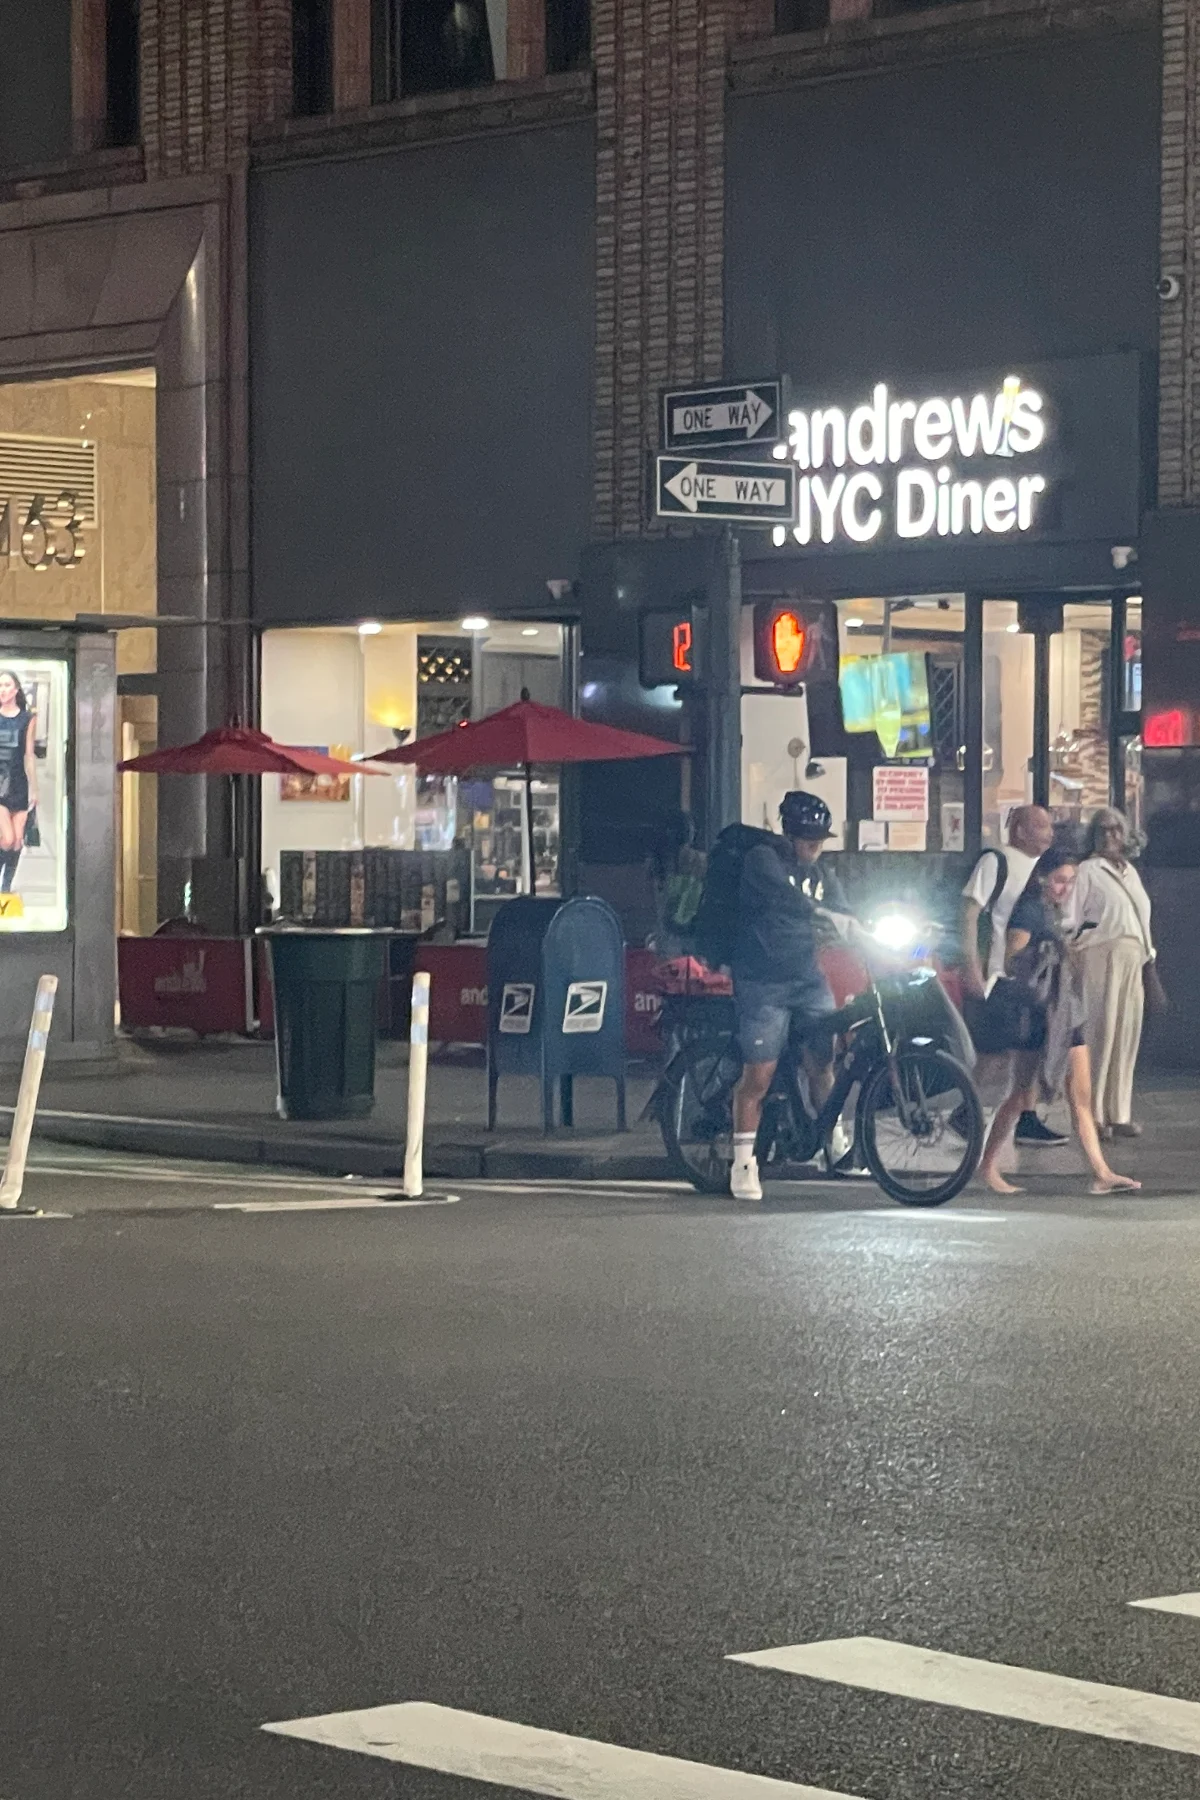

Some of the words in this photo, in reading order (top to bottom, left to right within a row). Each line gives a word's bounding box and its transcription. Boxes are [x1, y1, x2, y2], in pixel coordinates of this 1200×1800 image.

[683, 408, 713, 430] ONE
[728, 402, 762, 426] WAY
[680, 477, 716, 499] ONE
[735, 480, 776, 503] WAY
[896, 465, 1046, 538] Diner
